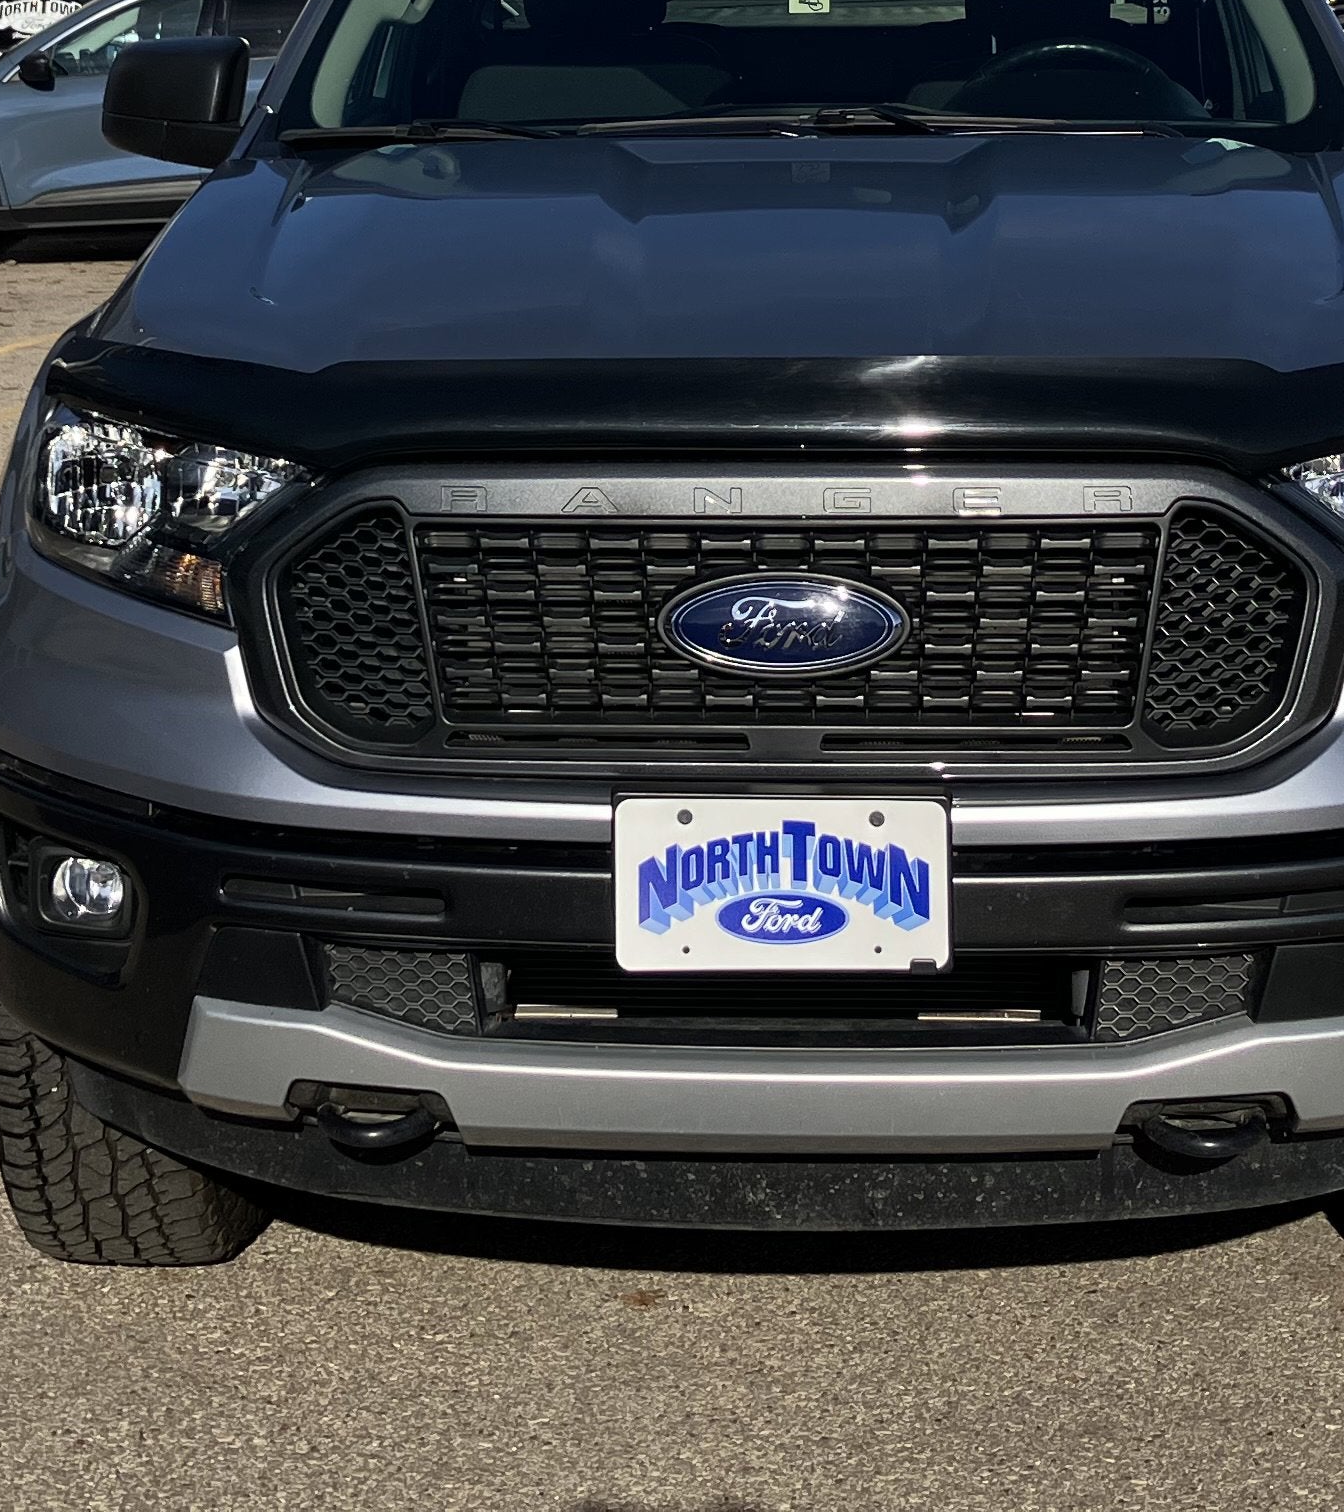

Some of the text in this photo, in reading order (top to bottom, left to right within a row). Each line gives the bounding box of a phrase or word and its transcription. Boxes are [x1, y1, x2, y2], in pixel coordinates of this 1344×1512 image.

[440, 485, 1133, 515] RANGER
[718, 596, 845, 650] Ford
[740, 897, 823, 934] Ford
